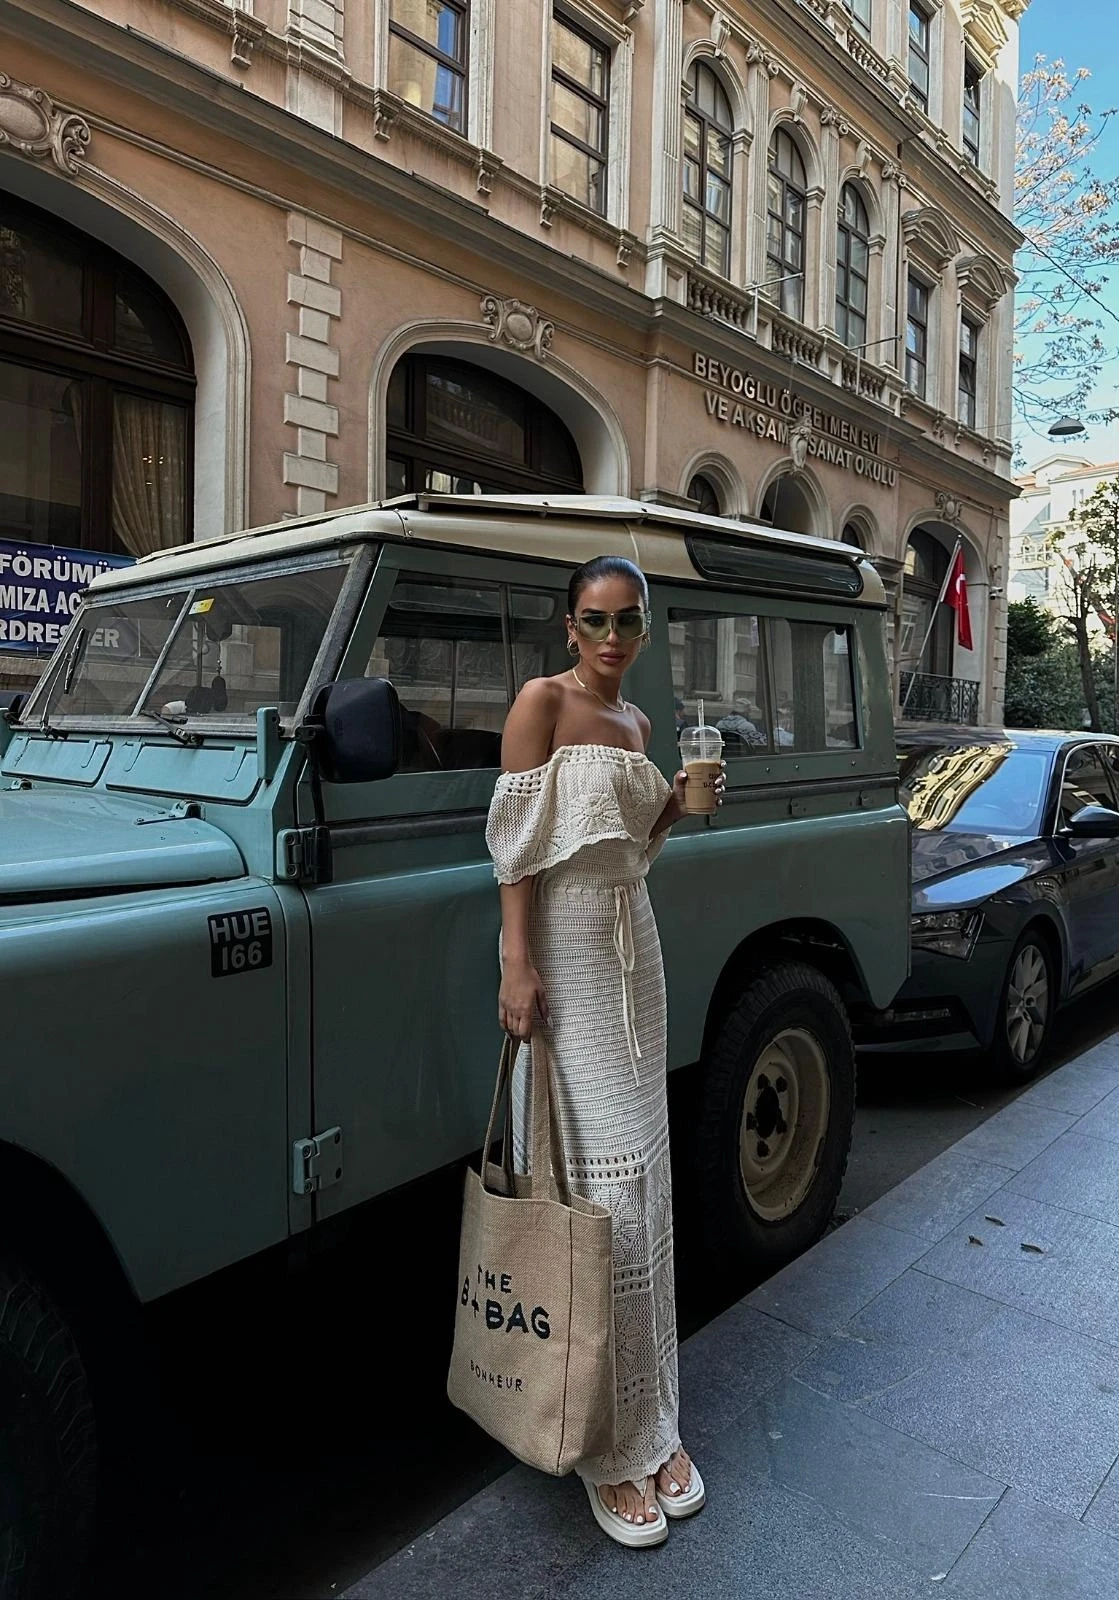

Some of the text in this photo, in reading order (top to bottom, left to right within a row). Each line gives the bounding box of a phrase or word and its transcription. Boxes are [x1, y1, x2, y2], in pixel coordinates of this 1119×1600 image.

[694, 351, 777, 408] BEYOĞLU
[704, 389, 897, 487] VE AKŞAM SANAT OKULU
[0, 584, 50, 613] MIZA
[210, 911, 270, 944] HUE
[222, 941, 262, 971] 166
[477, 1263, 513, 1294] THE
[470, 1359, 523, 1392] BONHEUR
